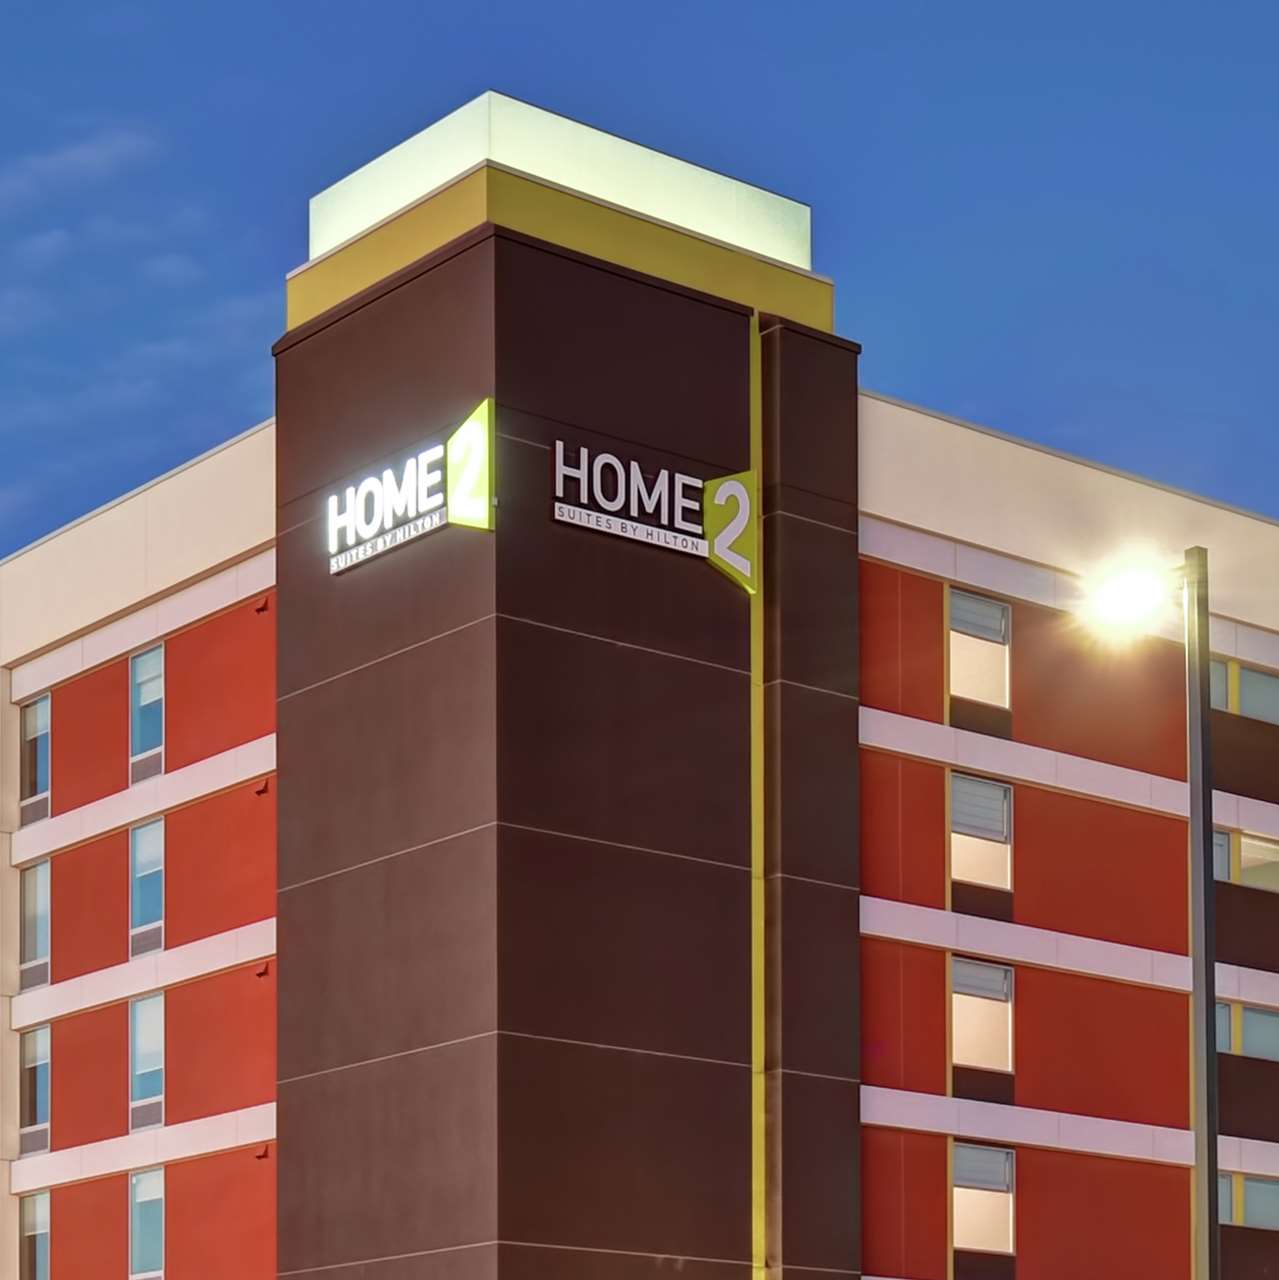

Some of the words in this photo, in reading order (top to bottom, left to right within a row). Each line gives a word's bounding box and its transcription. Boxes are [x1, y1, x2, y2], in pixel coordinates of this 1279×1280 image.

[328, 444, 444, 553] HOME
[449, 420, 486, 520] 2
[556, 440, 704, 535] HOME
[714, 480, 751, 577] 2
[558, 505, 612, 530] SUITES
[620, 522, 639, 537] BY
[646, 531, 700, 551] HILTON
[330, 543, 373, 572] SUITES
[396, 512, 440, 541] HILTON
